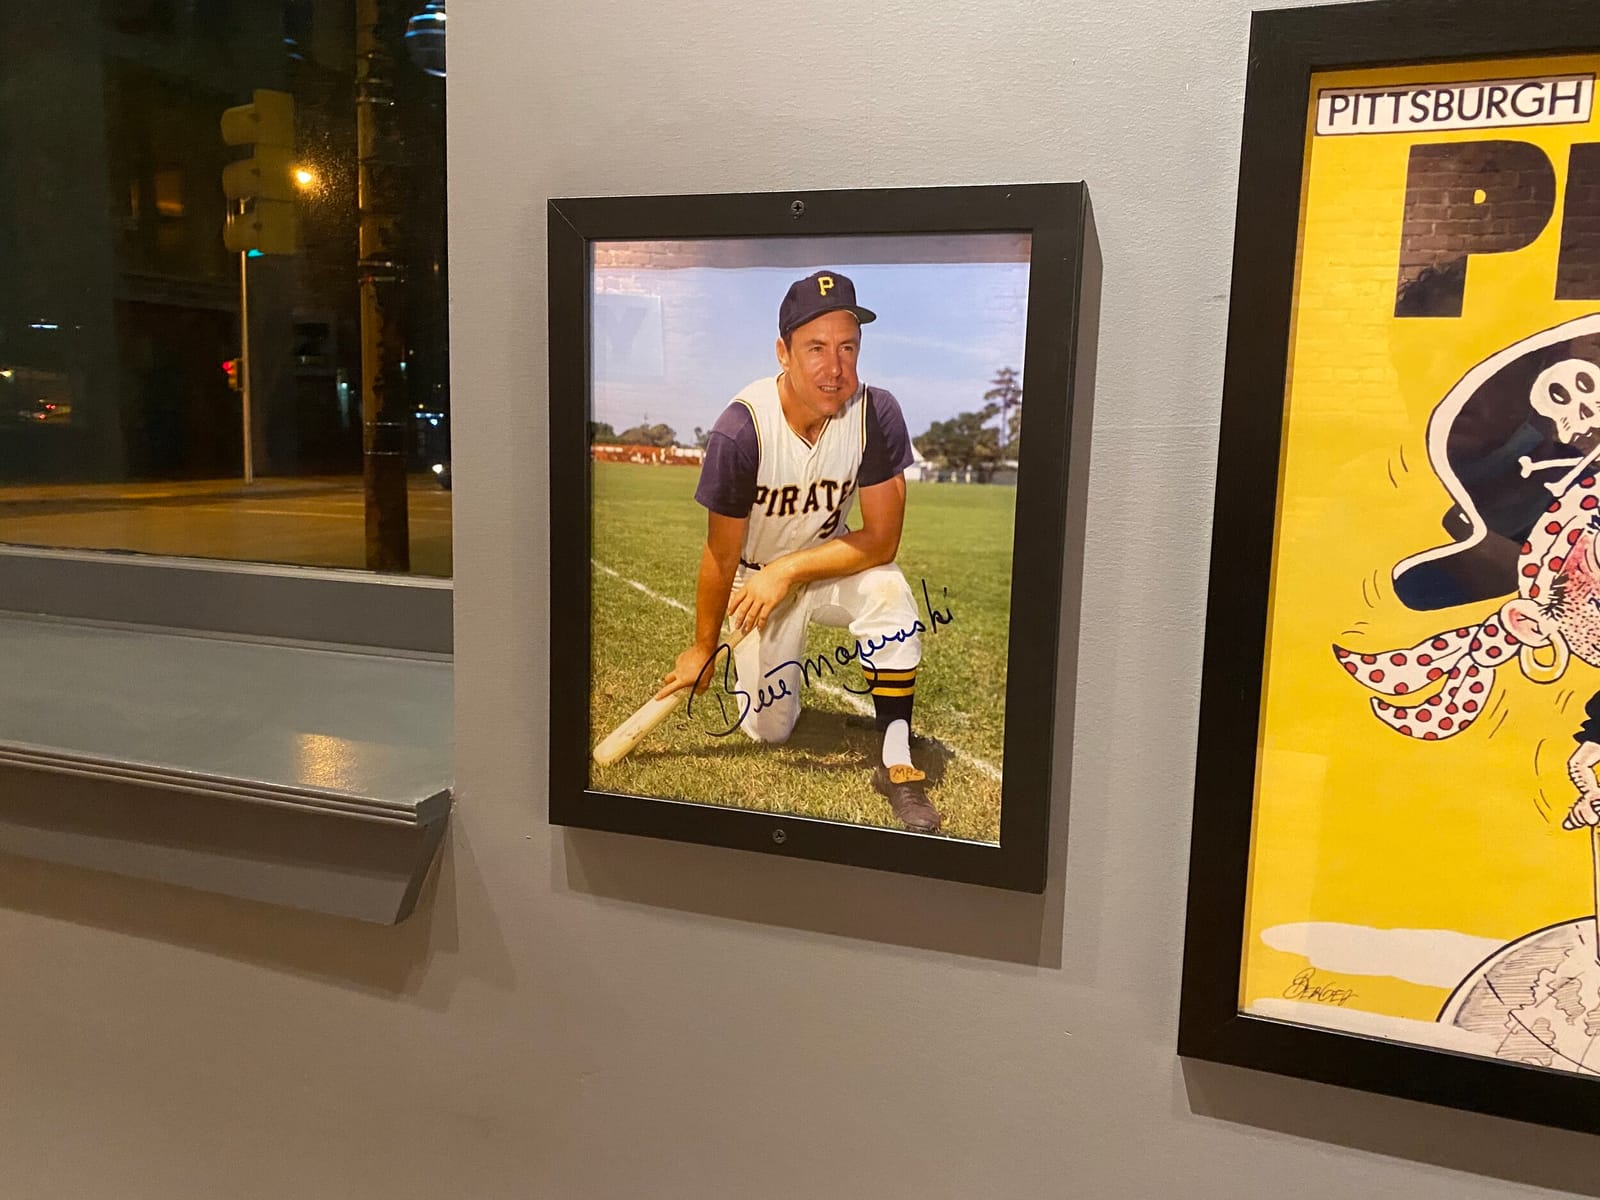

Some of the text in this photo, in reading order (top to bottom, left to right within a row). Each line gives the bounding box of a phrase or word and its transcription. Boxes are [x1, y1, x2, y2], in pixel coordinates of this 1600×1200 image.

[1328, 80, 1583, 127] PITTSBURGH
[817, 276, 835, 296] P
[753, 478, 857, 517] PIRATE
